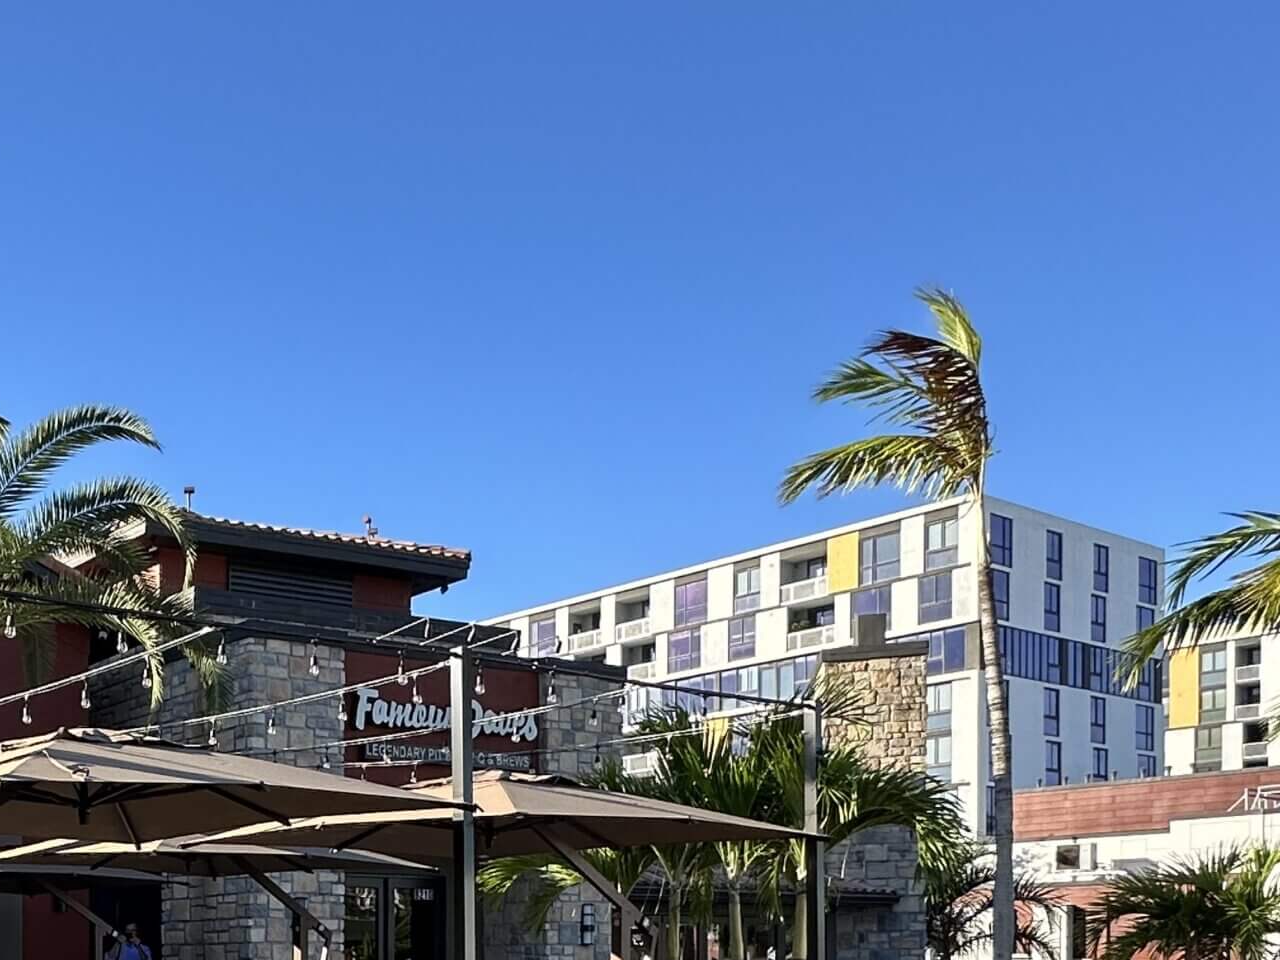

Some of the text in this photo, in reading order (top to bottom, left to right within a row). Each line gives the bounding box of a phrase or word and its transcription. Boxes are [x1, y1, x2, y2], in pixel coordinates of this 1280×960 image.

[355, 687, 452, 731] Famou
[366, 743, 426, 761] LEGENDARY
[495, 754, 530, 768] BREWS
